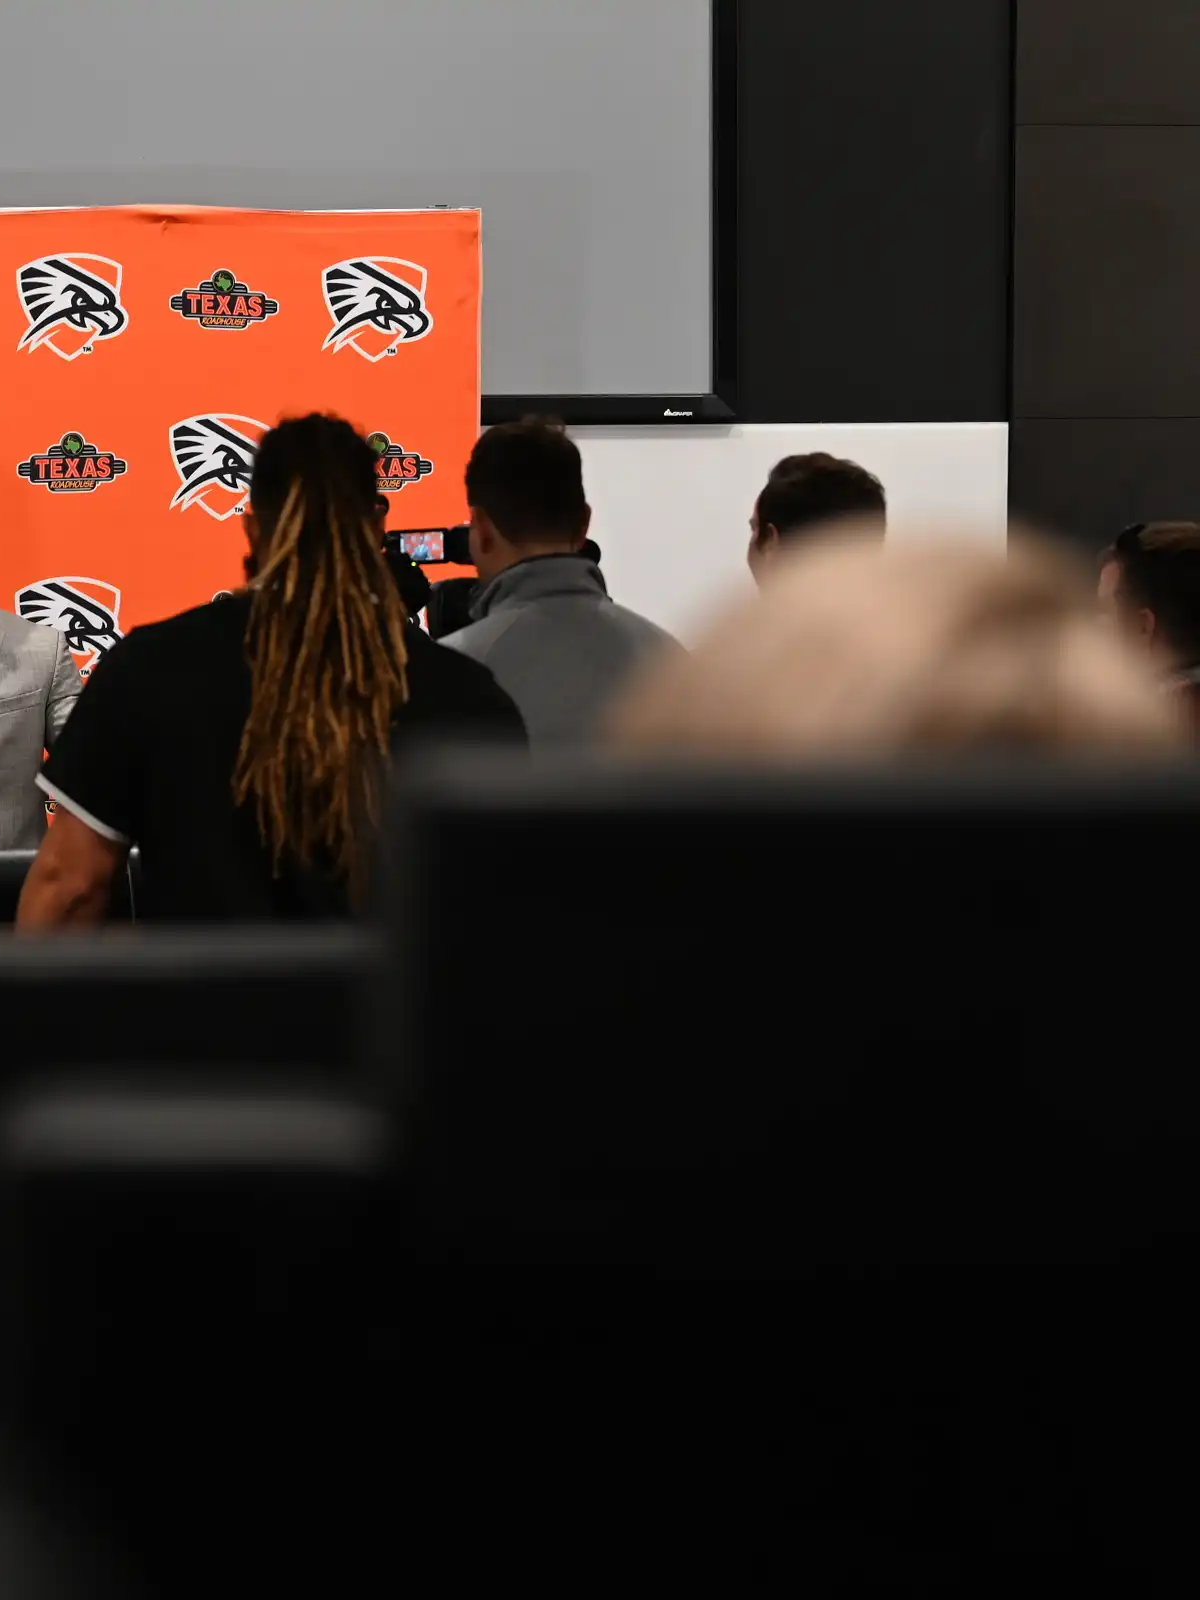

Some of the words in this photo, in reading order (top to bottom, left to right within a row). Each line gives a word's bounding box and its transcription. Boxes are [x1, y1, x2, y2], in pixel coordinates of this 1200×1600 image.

[186, 294, 263, 317] TEXAS
[201, 317, 247, 326] ROADHOUSE
[35, 456, 111, 479] TEXAS
[375, 457, 417, 477] XAS
[50, 480, 95, 489] ROADHOUSE
